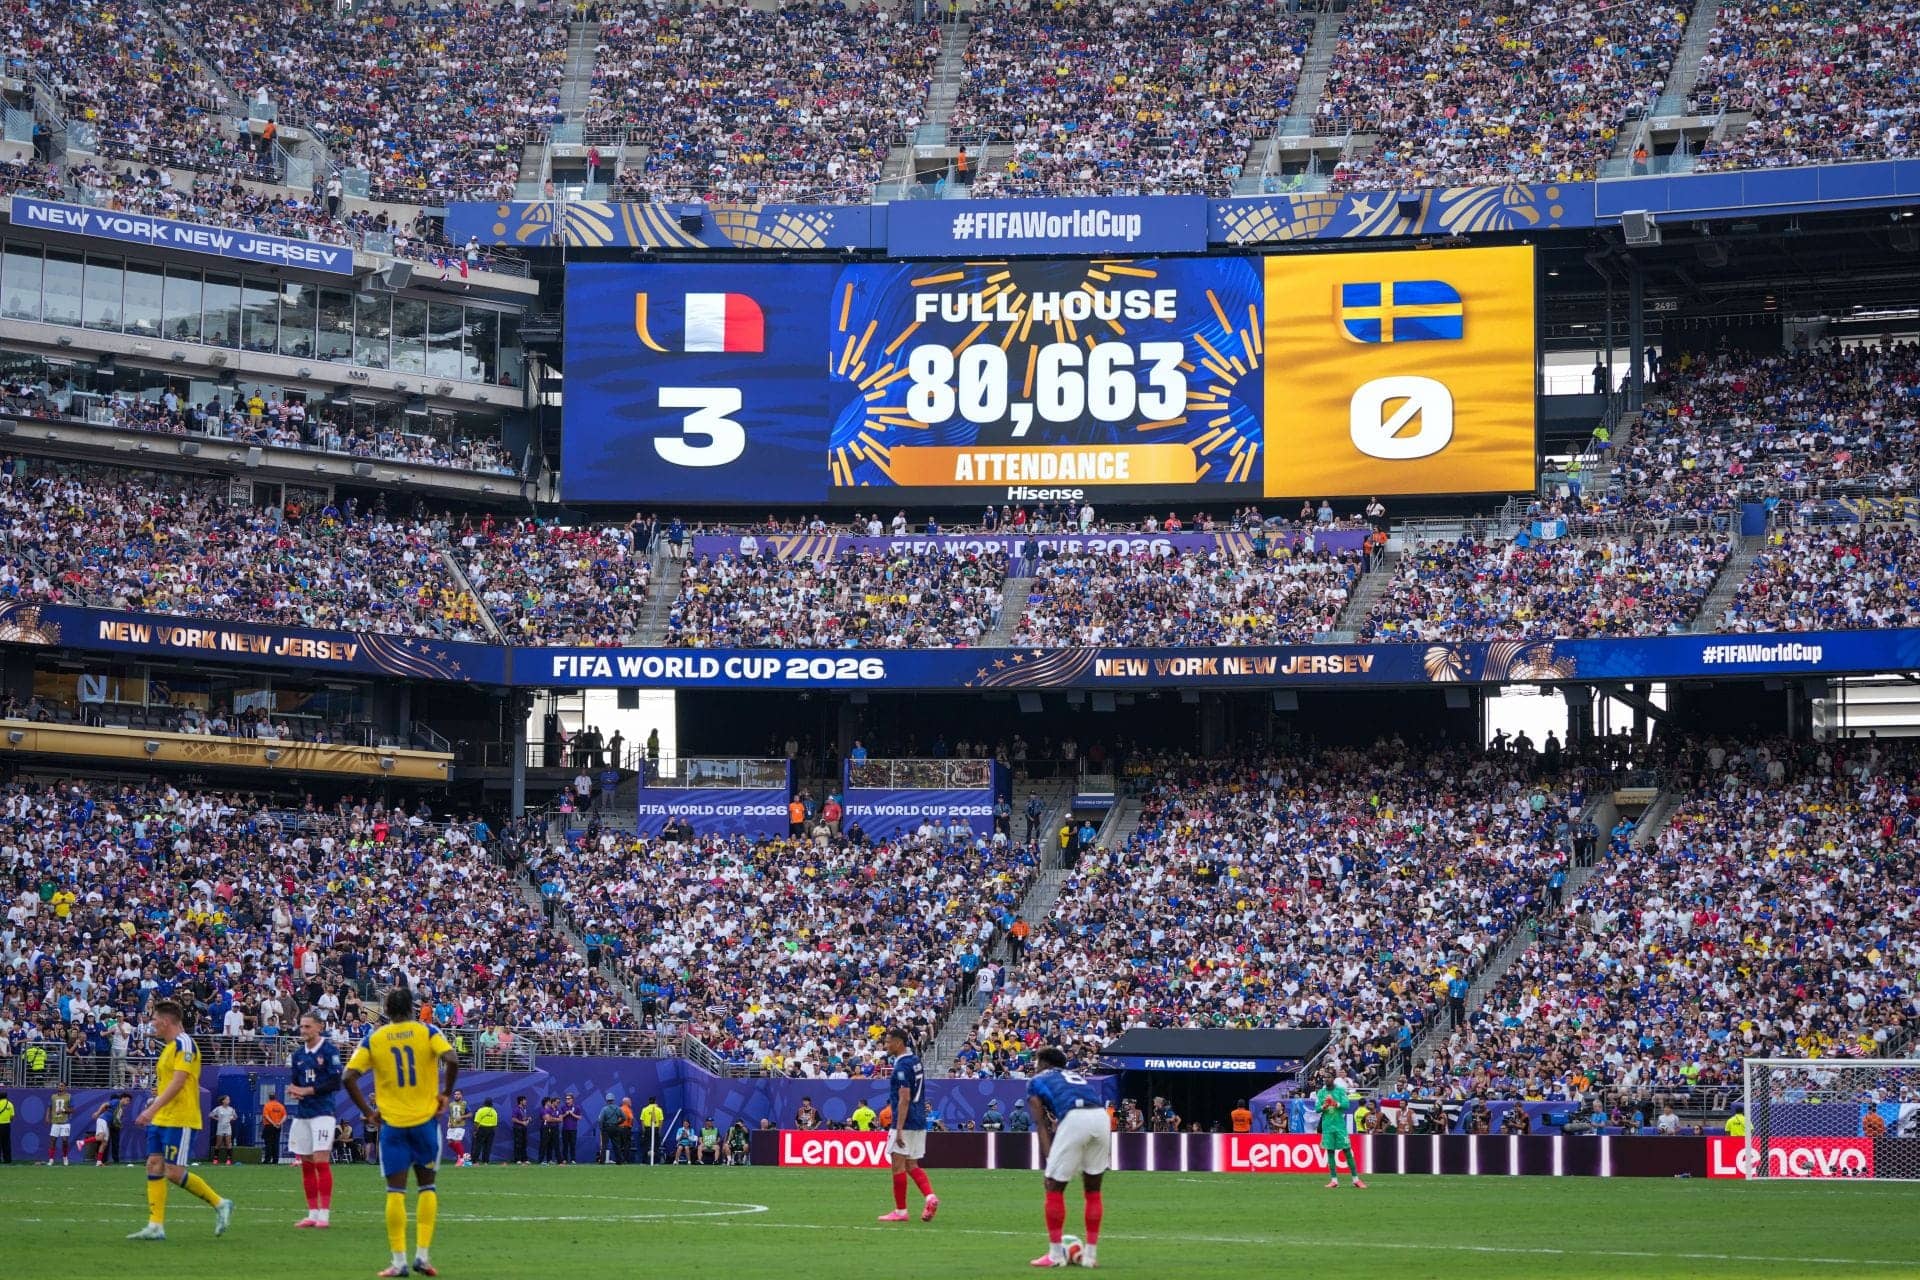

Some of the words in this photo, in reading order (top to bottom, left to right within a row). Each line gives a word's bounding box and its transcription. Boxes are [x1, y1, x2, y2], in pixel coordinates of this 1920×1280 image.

[27, 205, 89, 227] NEW
[96, 216, 169, 240] YORK
[174, 227, 233, 250] NEW
[238, 239, 338, 265] JERSEY
[952, 209, 1141, 242] #FIFAWorldCup
[915, 292, 1019, 322] FULL
[1033, 289, 1177, 321] HOUSE
[906, 342, 1187, 437] 80,663
[653, 387, 746, 467] 3
[1350, 375, 1453, 460] 0
[955, 452, 1130, 481] ATTENDANCE
[1007, 486, 1084, 500] Hisense
[889, 541, 940, 556] FIFA
[1087, 538, 1172, 559] 2026
[99, 620, 151, 644] NEW
[157, 626, 217, 650] YORK
[221, 631, 272, 655] NEW
[275, 637, 358, 662] JERSEY
[1702, 643, 1822, 664] #FIFAWorldCup
[552, 656, 613, 677] FIFA
[617, 656, 719, 679] WORLD
[724, 657, 781, 679] CUP
[786, 658, 885, 680] 2026
[1095, 658, 1149, 677] NEW
[1155, 657, 1218, 676] YORK
[1223, 656, 1277, 675] NEW
[1281, 654, 1374, 675] JERSEY
[639, 804, 665, 815] FIFA
[668, 805, 714, 815] WORLD
[716, 805, 742, 816] CUP
[743, 805, 788, 816] 2026
[846, 805, 872, 815] FIFA
[874, 805, 919, 816] WORLD
[921, 805, 947, 816] CUP
[948, 805, 993, 816] 2026
[305, 1069, 316, 1083] 14
[390, 1045, 417, 1088] 11
[1144, 1059, 1165, 1068] FIFA
[1166, 1060, 1200, 1069] WORLD
[1202, 1060, 1222, 1069] CUP
[1222, 1061, 1257, 1070] 2026
[913, 1073, 924, 1103] 7
[318, 1129, 329, 1142] 14
[165, 1144, 178, 1161] 17
[1713, 1139, 1867, 1176] Lenovo
